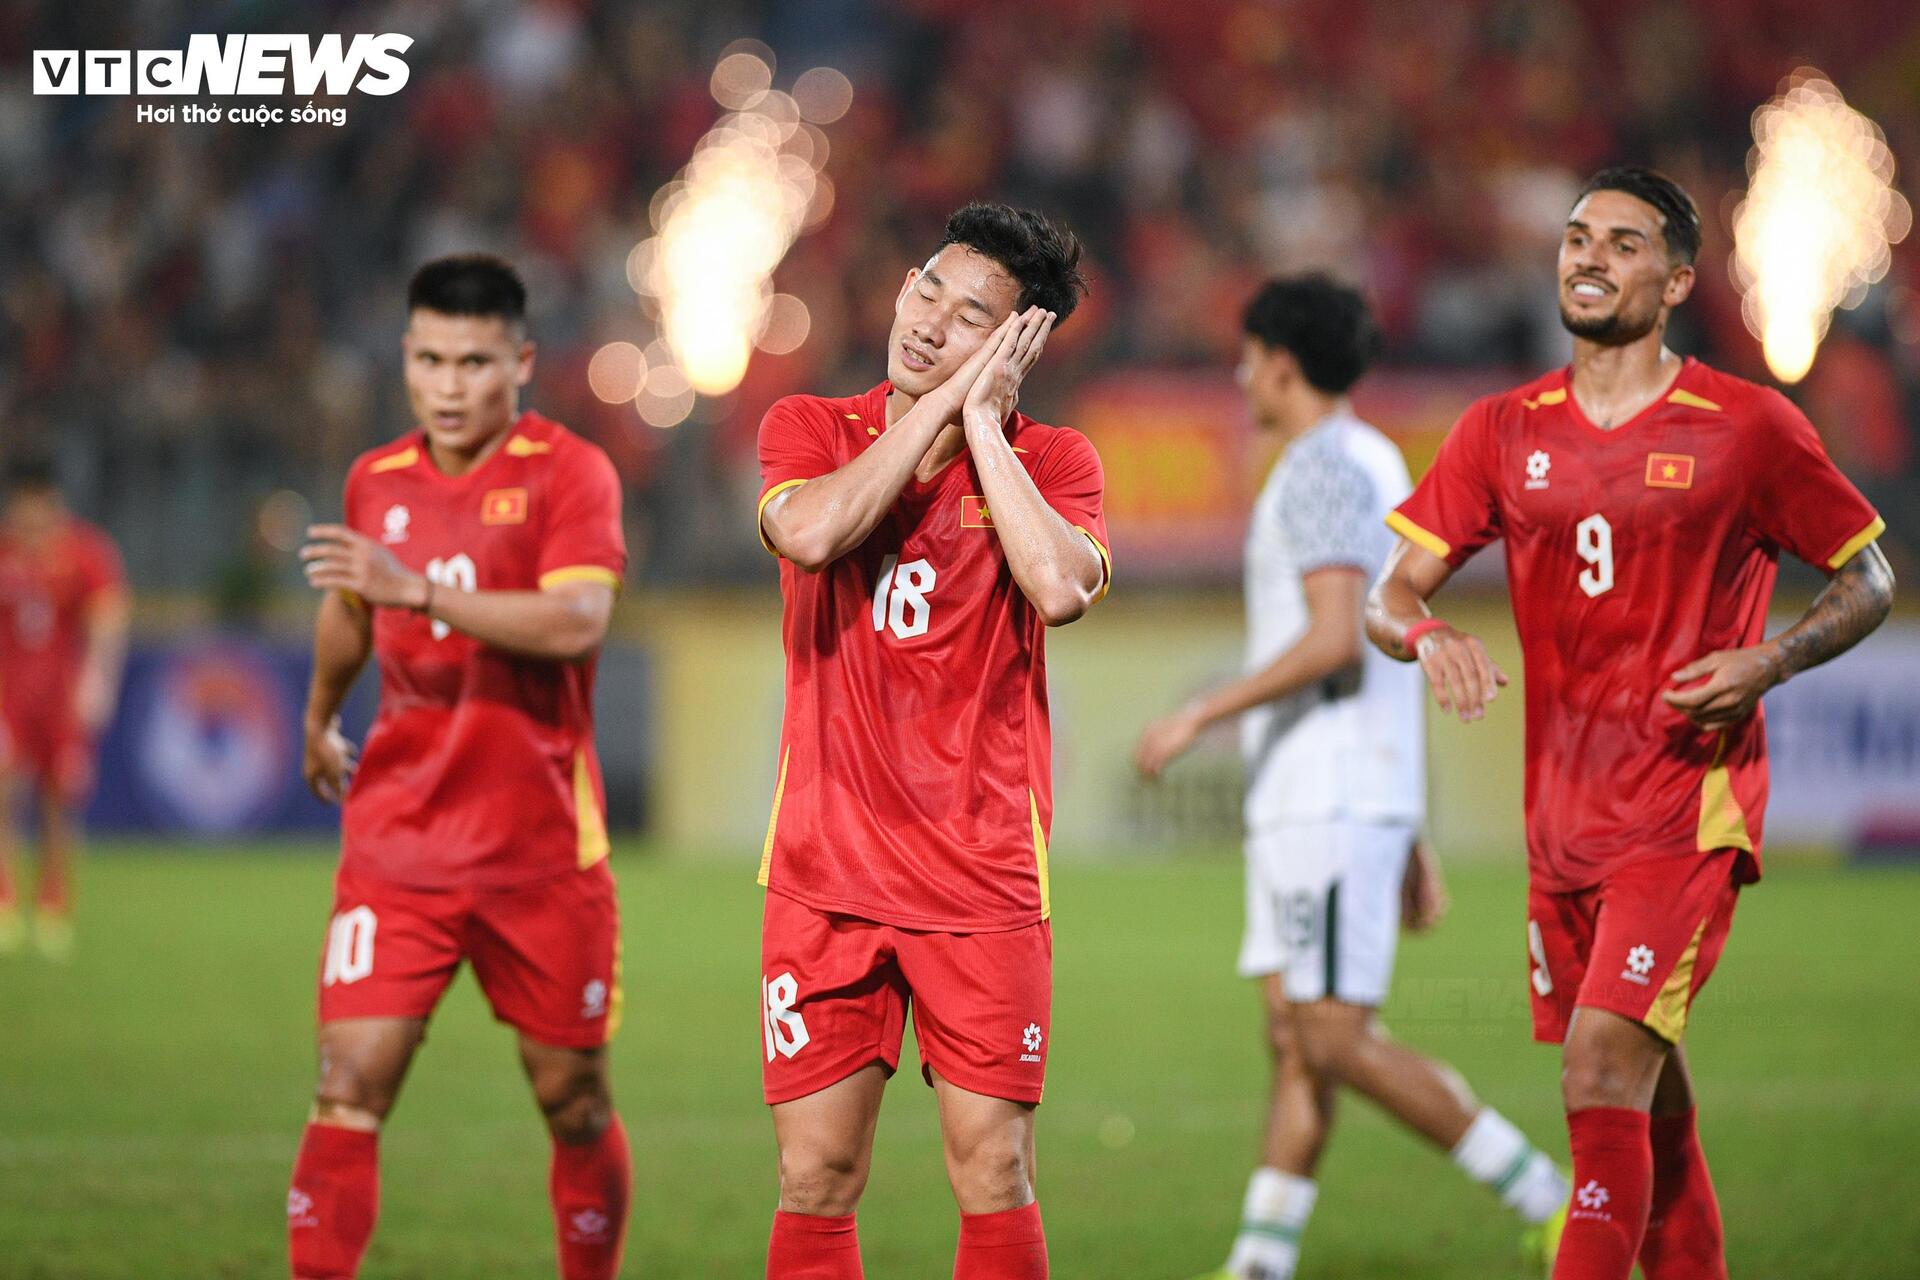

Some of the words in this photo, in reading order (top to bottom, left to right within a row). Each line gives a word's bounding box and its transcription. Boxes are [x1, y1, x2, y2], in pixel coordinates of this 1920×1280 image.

[872, 554, 936, 639] 18
[1576, 513, 1614, 598] 9
[323, 904, 377, 987] 10
[762, 972, 810, 1063] 18
